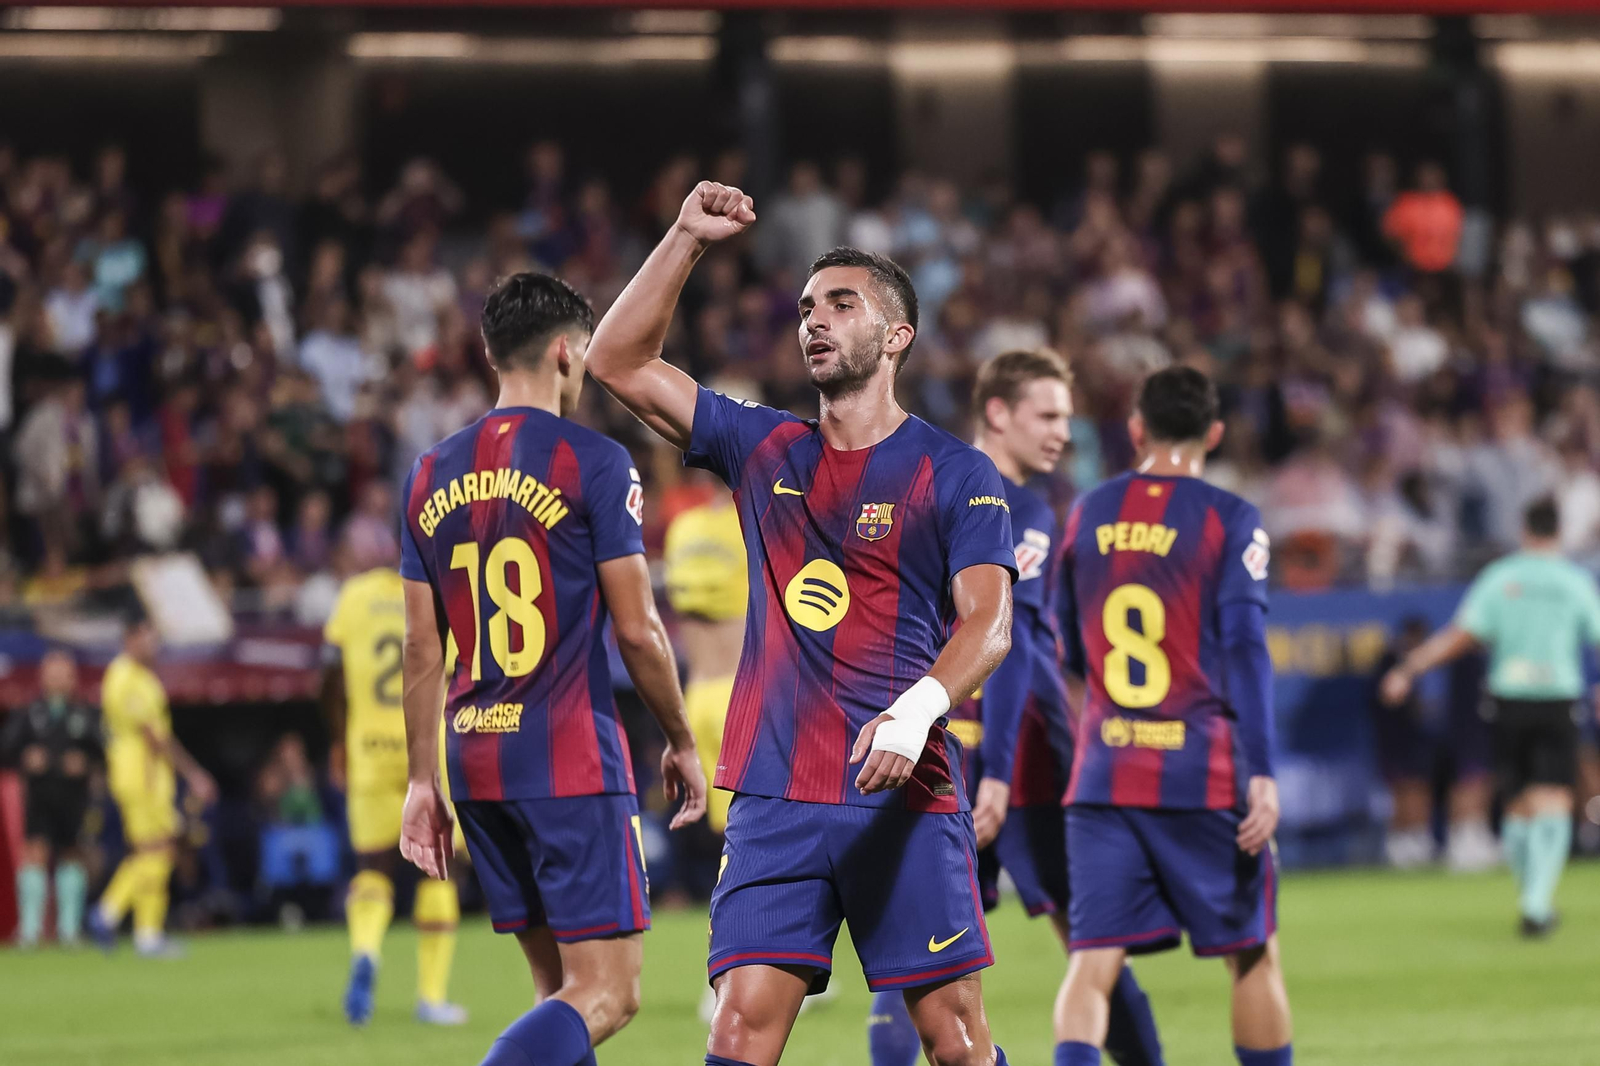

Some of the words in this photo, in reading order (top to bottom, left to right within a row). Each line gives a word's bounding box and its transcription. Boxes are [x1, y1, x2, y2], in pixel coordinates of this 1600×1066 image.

[418, 468, 569, 538] GERARDMARTÍN
[1096, 521, 1178, 557] PEDRI
[450, 537, 546, 681] 18
[1103, 583, 1171, 708] 8
[476, 715, 520, 729] ACNUR
